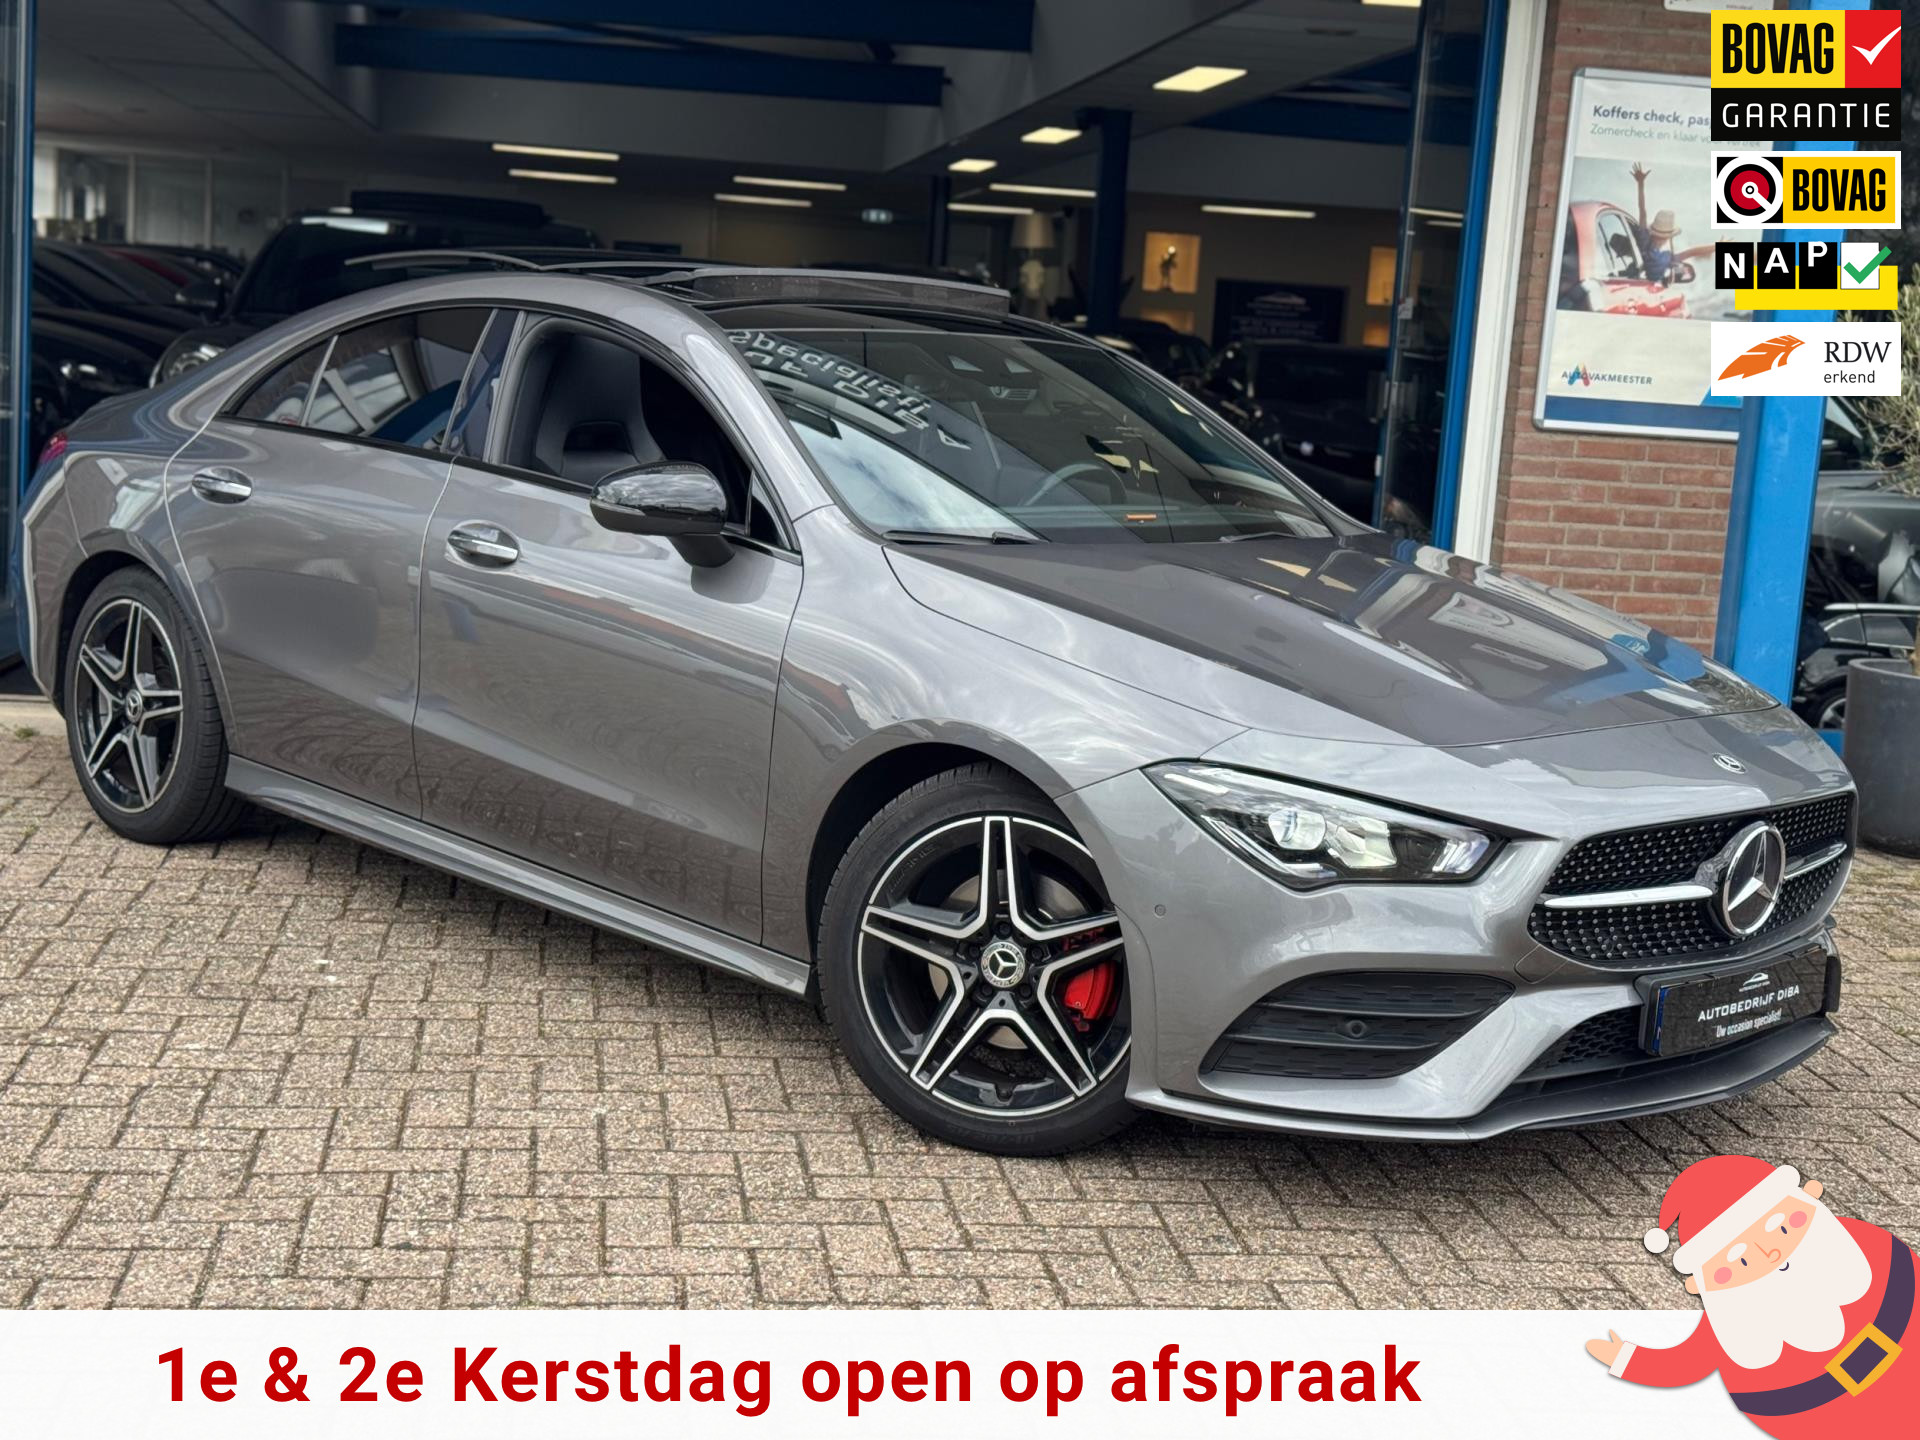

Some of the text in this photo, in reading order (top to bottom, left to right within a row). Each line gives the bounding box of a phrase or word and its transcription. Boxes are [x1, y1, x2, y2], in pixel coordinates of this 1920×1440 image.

[1593, 105, 1711, 130] Koffers check, pas
[1590, 123, 1655, 139] Zomercheck
[1657, 130, 1669, 140] en
[1673, 130, 1698, 142] klaar
[1562, 371, 1653, 385] AUTOVAKMEESTER
[1698, 992, 1775, 1022] AUTOBEDRIJF
[1777, 985, 1799, 1001] DIBA
[1716, 1025, 1726, 1038] Uw
[1727, 1019, 1753, 1036] occasion
